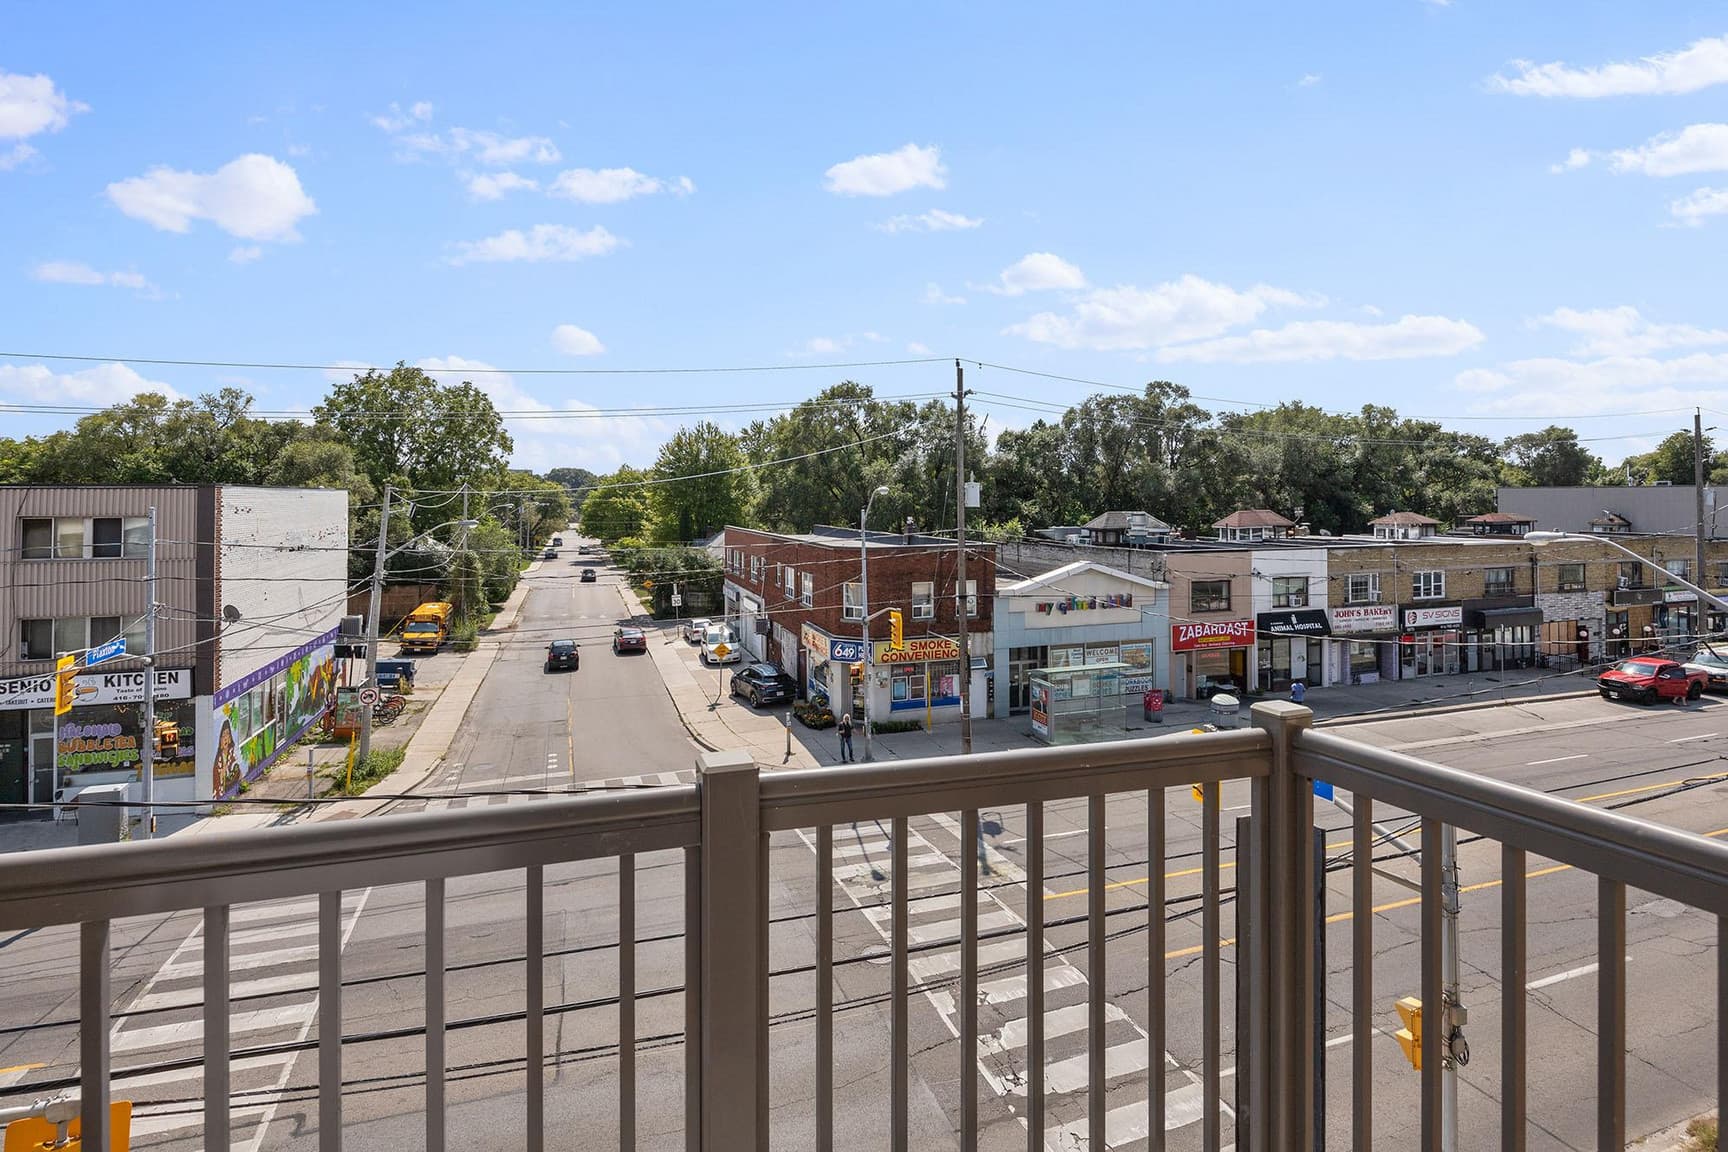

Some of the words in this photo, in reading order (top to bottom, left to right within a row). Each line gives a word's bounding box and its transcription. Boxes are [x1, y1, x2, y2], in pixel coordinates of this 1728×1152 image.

[1036, 602, 1055, 616] my
[1056, 595, 1097, 615] gifted
[1334, 609, 1362, 618] JOHN'S
[1363, 607, 1393, 617] BAKERY
[1179, 622, 1249, 642] ZABARDAST
[1270, 624, 1295, 632] ANIMAL
[1294, 622, 1323, 631] HOSPITAL
[910, 640, 952, 651] SMOKE
[1086, 647, 1118, 657] WELCOME
[881, 648, 960, 663] CONVENIENC
[104, 671, 179, 688] KITCEN
